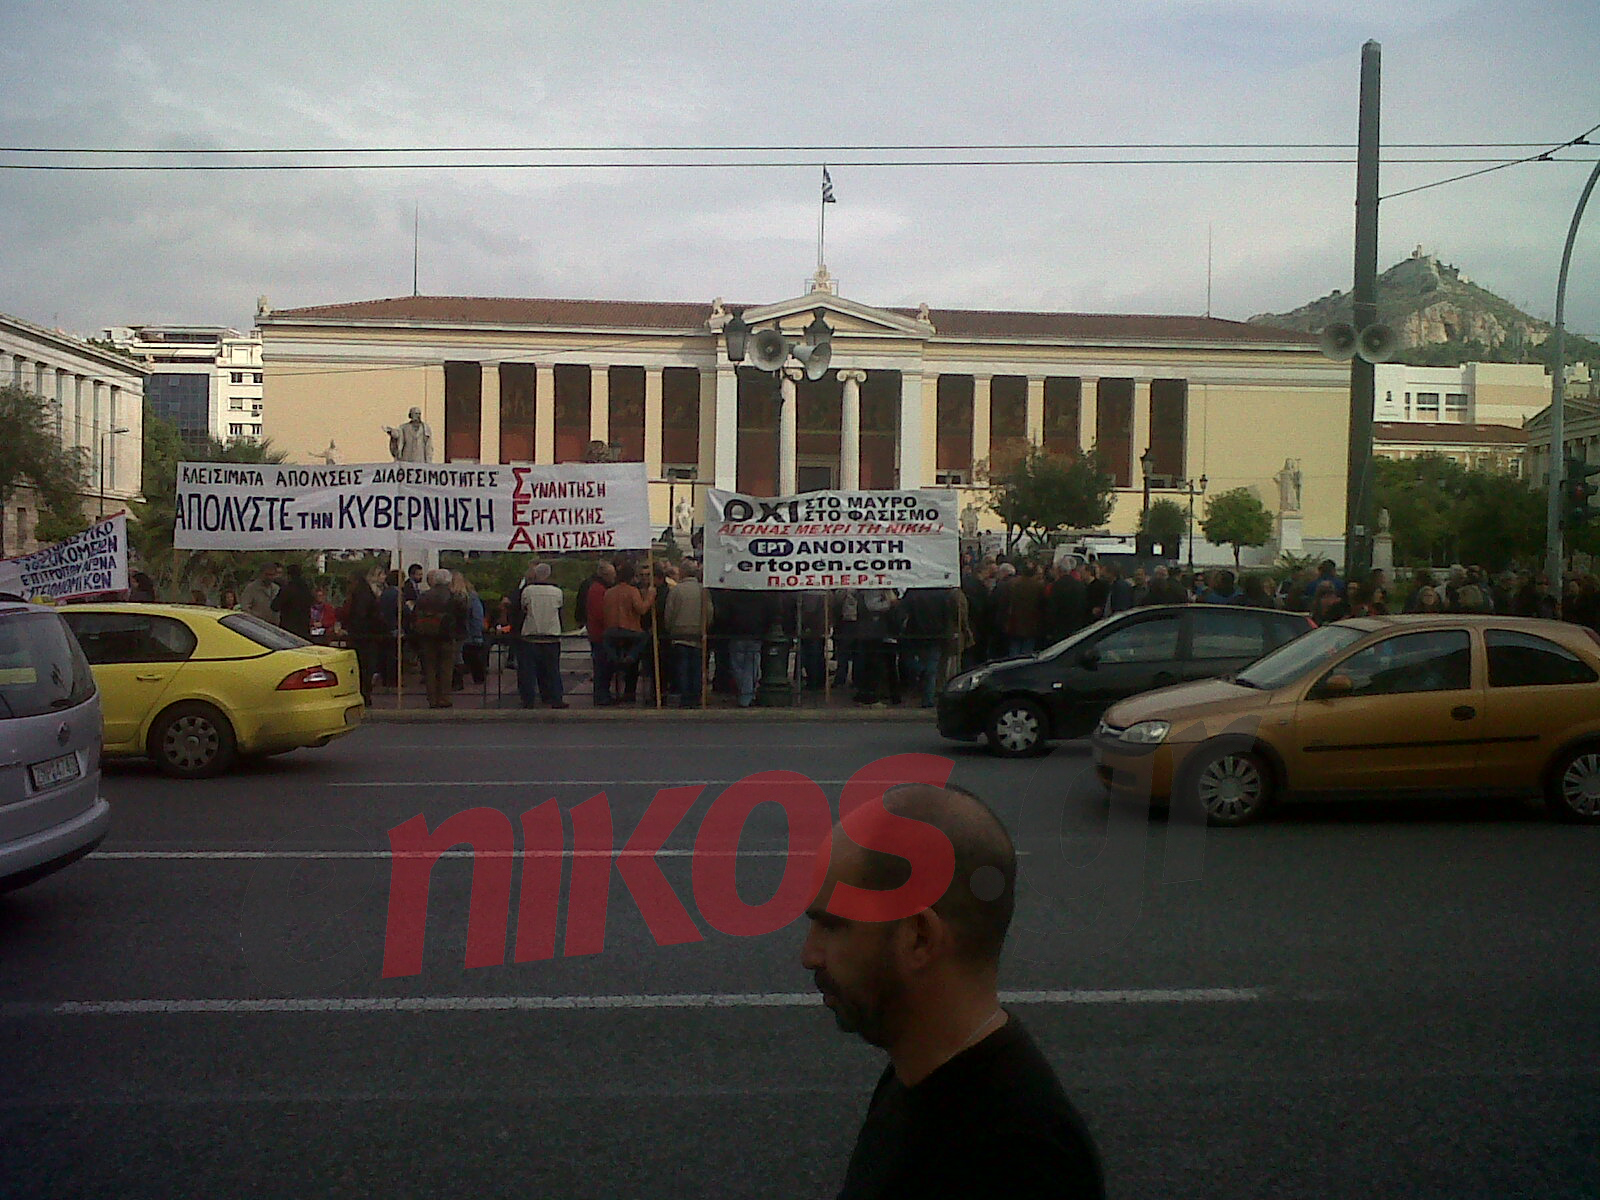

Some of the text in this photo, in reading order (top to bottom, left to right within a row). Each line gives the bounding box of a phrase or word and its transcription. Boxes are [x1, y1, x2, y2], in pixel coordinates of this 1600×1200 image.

[182, 466, 499, 487] ΚΛΕΙΣΙΜΑΤΑ ΑΠΟΛΥΣΕΙΣ ΔΙΑΘΕΣΙΜΟΤΗΤΕΣ
[512, 467, 606, 499] ΣΥΝΑΝΤΗΣΗ
[175, 493, 296, 532] ΑΠΟΛΥΣΤΕ
[338, 494, 495, 533] ΚΥΒΕΡΝΗΣΗ
[512, 500, 605, 526] ΕΡΓΑΤΙΚΗΣ
[723, 498, 799, 523] ΟΧΙ
[805, 496, 918, 509] ΣΤΟ ΜΑΥΡΟ
[804, 509, 939, 522] ΣΤΟ ΦΑΣΙΣΜΟ
[507, 527, 616, 550] ΑΝΤΙΣΤΑΣΗΣ
[718, 523, 791, 535] ΑΓΩΝΑΣ
[794, 523, 851, 535] ΜΕΧΡΙ
[857, 523, 885, 534] ΤΗ
[755, 540, 904, 555] ΕΡΤ ΑΝΟΙΧΤΗ
[737, 557, 911, 575] ertopen.com
